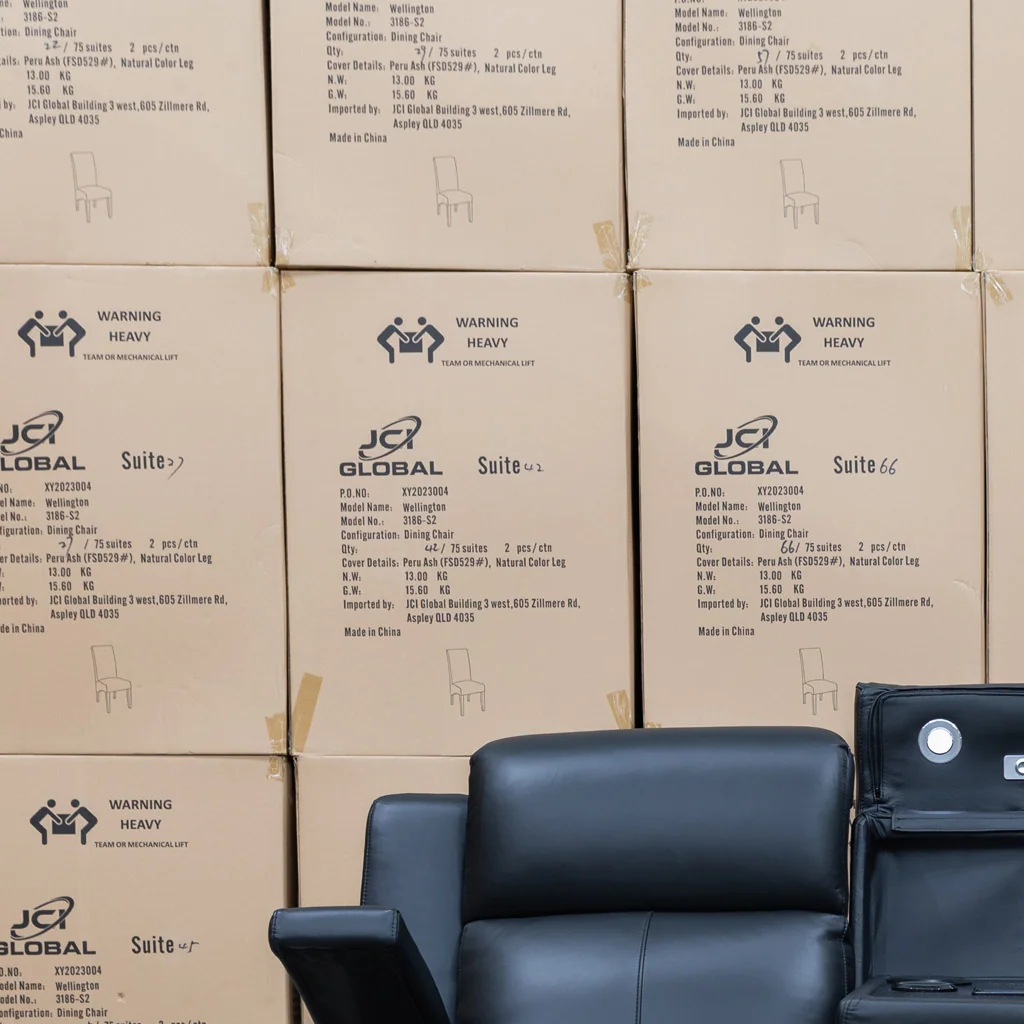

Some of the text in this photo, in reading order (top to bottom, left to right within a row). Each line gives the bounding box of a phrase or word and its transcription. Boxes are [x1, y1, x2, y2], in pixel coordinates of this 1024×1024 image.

[326, 2, 434, 15] Model Name: Wellington
[675, 8, 781, 18] Model Name: Wellington
[326, 31, 441, 44] Configuration: Dining Chair
[28, 99, 209, 112] JCI Global Building 3 west,605 Zillmere Rd,
[677, 107, 916, 120] Imported by: JCI Global Building 3 west,605 Zillmere Rd,
[29, 114, 99, 126] Aspley QLD 4035
[330, 133, 387, 143] Made in China
[97, 311, 161, 321] WARNING
[456, 317, 518, 328] WARNING
[813, 317, 875, 327] WARNING
[109, 331, 150, 342] HEAVY
[468, 338, 508, 348] HEAVY
[824, 337, 864, 348] HEAVY
[0, 456, 86, 471] LOBAL
[122, 451, 165, 470] Suite
[478, 456, 520, 474] Suite
[834, 456, 898, 475] Suite 66
[339, 461, 443, 476] GLOBAL
[695, 460, 798, 475] GLOBAL
[45, 481, 91, 492] XY2023004
[340, 486, 448, 498] P.O.NO: XY2023004
[758, 486, 804, 496] XY2023004
[341, 502, 446, 513] Model Name: Wellington
[696, 514, 791, 525] Model No.: 3186-S2
[697, 556, 919, 567] Cover Details: Peru Ash (FSD529#), Natural Color Leg
[343, 571, 447, 581] N.W: 13.00 KG
[697, 584, 804, 594] G.W: 15.60 KG
[51, 609, 119, 621] Aspley QLD 4035
[109, 799, 172, 810] WARNING
[121, 820, 161, 829] HEAVY
[0, 941, 96, 955] GLOBAL
[132, 936, 174, 954] Suite
[55, 966, 101, 976] XY2023004
